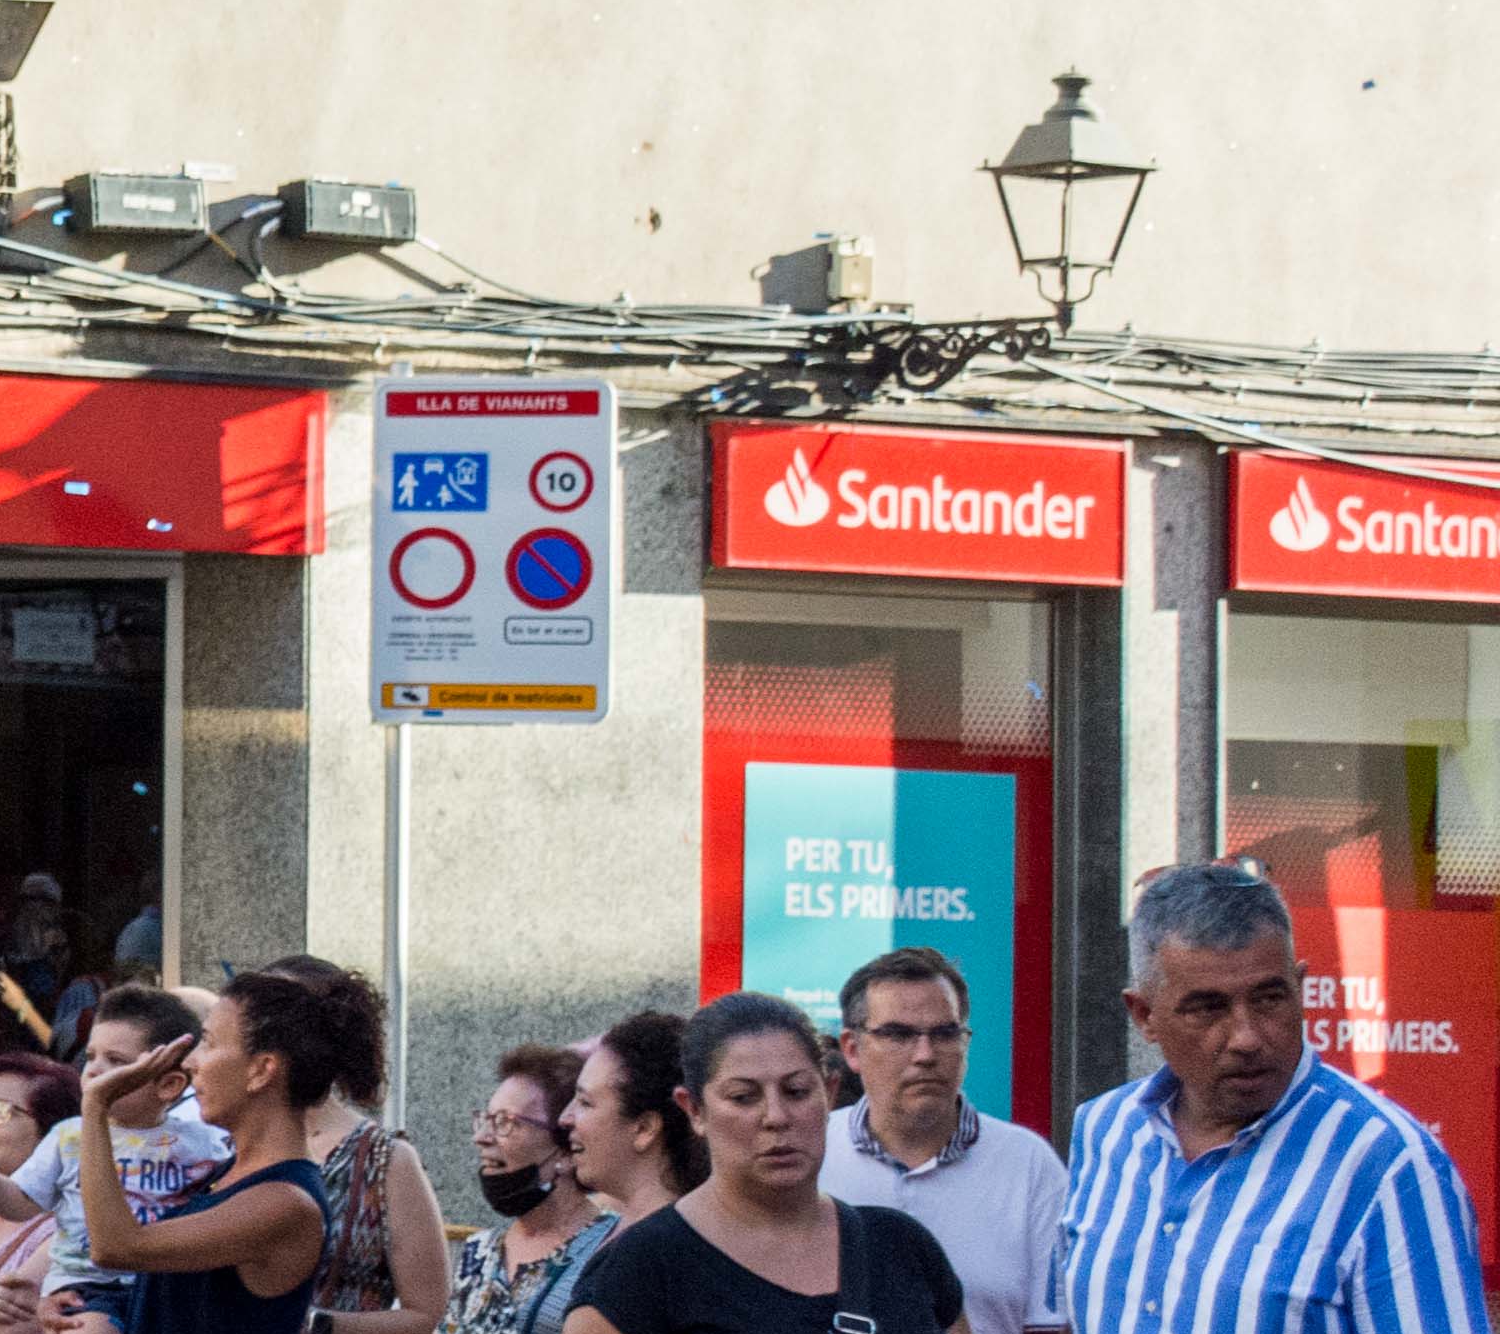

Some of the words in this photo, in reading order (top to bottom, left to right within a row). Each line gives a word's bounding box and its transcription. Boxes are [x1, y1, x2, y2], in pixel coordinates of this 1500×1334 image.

[416, 396, 451, 412] ILLA
[457, 396, 479, 411] DE
[485, 396, 569, 412] VIANANTS
[546, 472, 577, 493] 10
[835, 469, 1096, 540] Santander
[1335, 494, 1499, 560] Santan
[785, 837, 842, 873] PER
[847, 839, 895, 881] TU,
[784, 882, 836, 918] ELS
[841, 884, 976, 921] PRIMERS.
[1302, 975, 1337, 1010] ER
[1339, 976, 1386, 1016] TU,
[1302, 1019, 1331, 1052] LS
[1337, 1019, 1460, 1054] PRIMERS.
